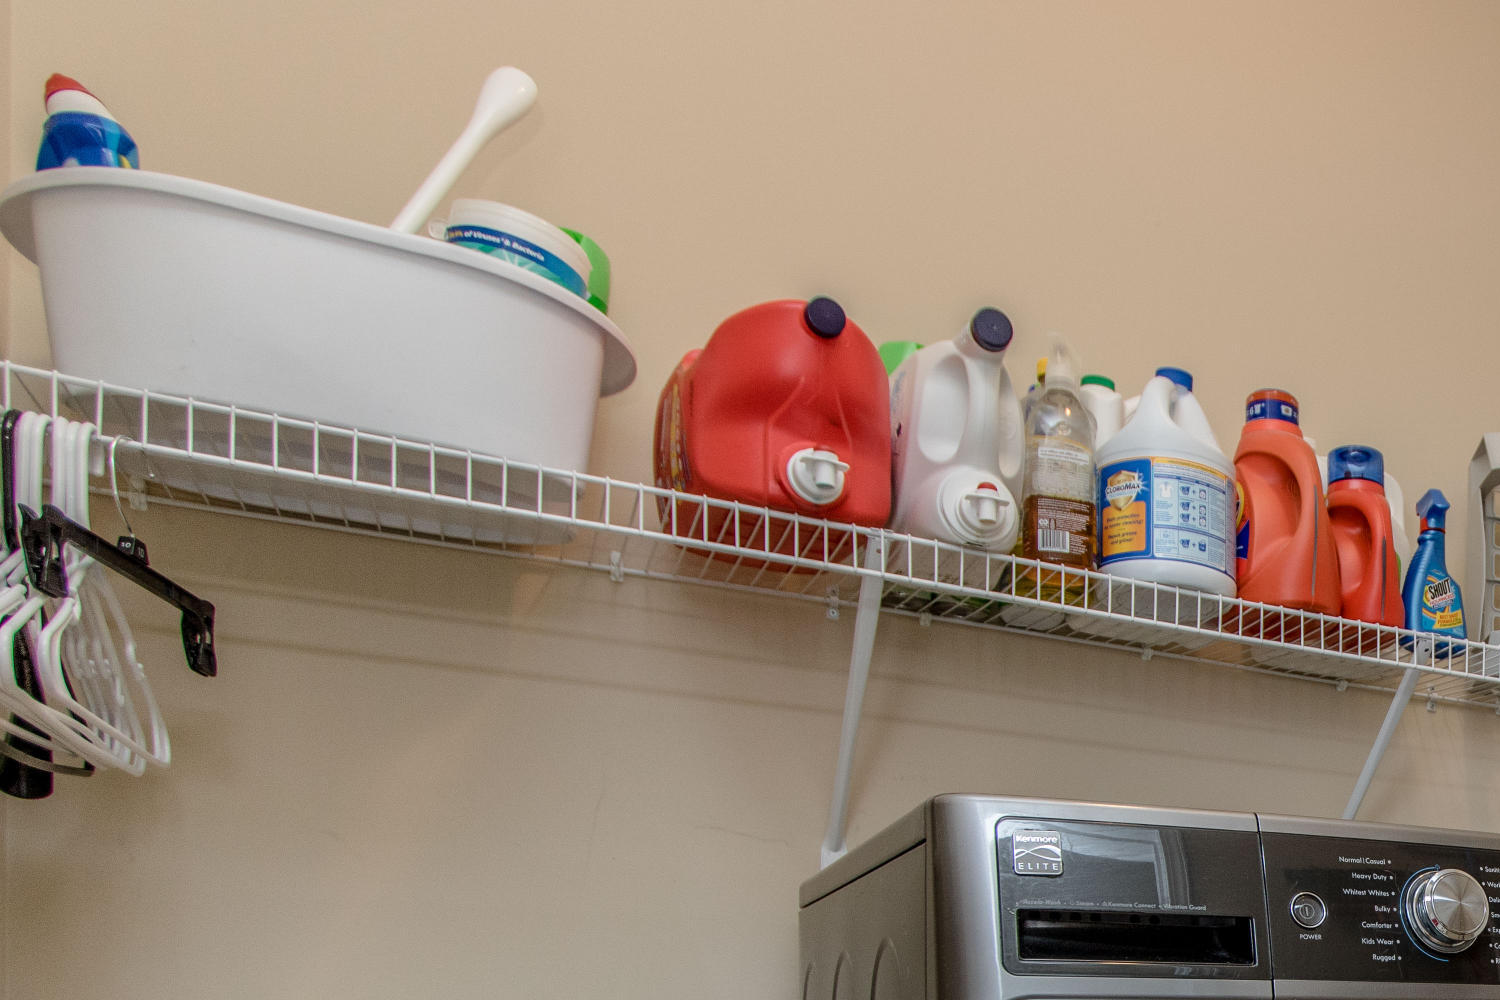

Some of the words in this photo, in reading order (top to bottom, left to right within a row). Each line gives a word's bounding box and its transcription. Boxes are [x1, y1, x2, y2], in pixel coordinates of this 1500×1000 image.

[512, 242, 545, 262] Bacteria
[1428, 578, 1451, 600] SHOUT
[1015, 834, 1058, 843] Kenmore
[1018, 862, 1059, 870] ELITE
[1352, 872, 1372, 882] Heavy
[1372, 873, 1387, 882] Duty
[1368, 889, 1390, 897] Whites
[1372, 954, 1396, 962] Rugged
